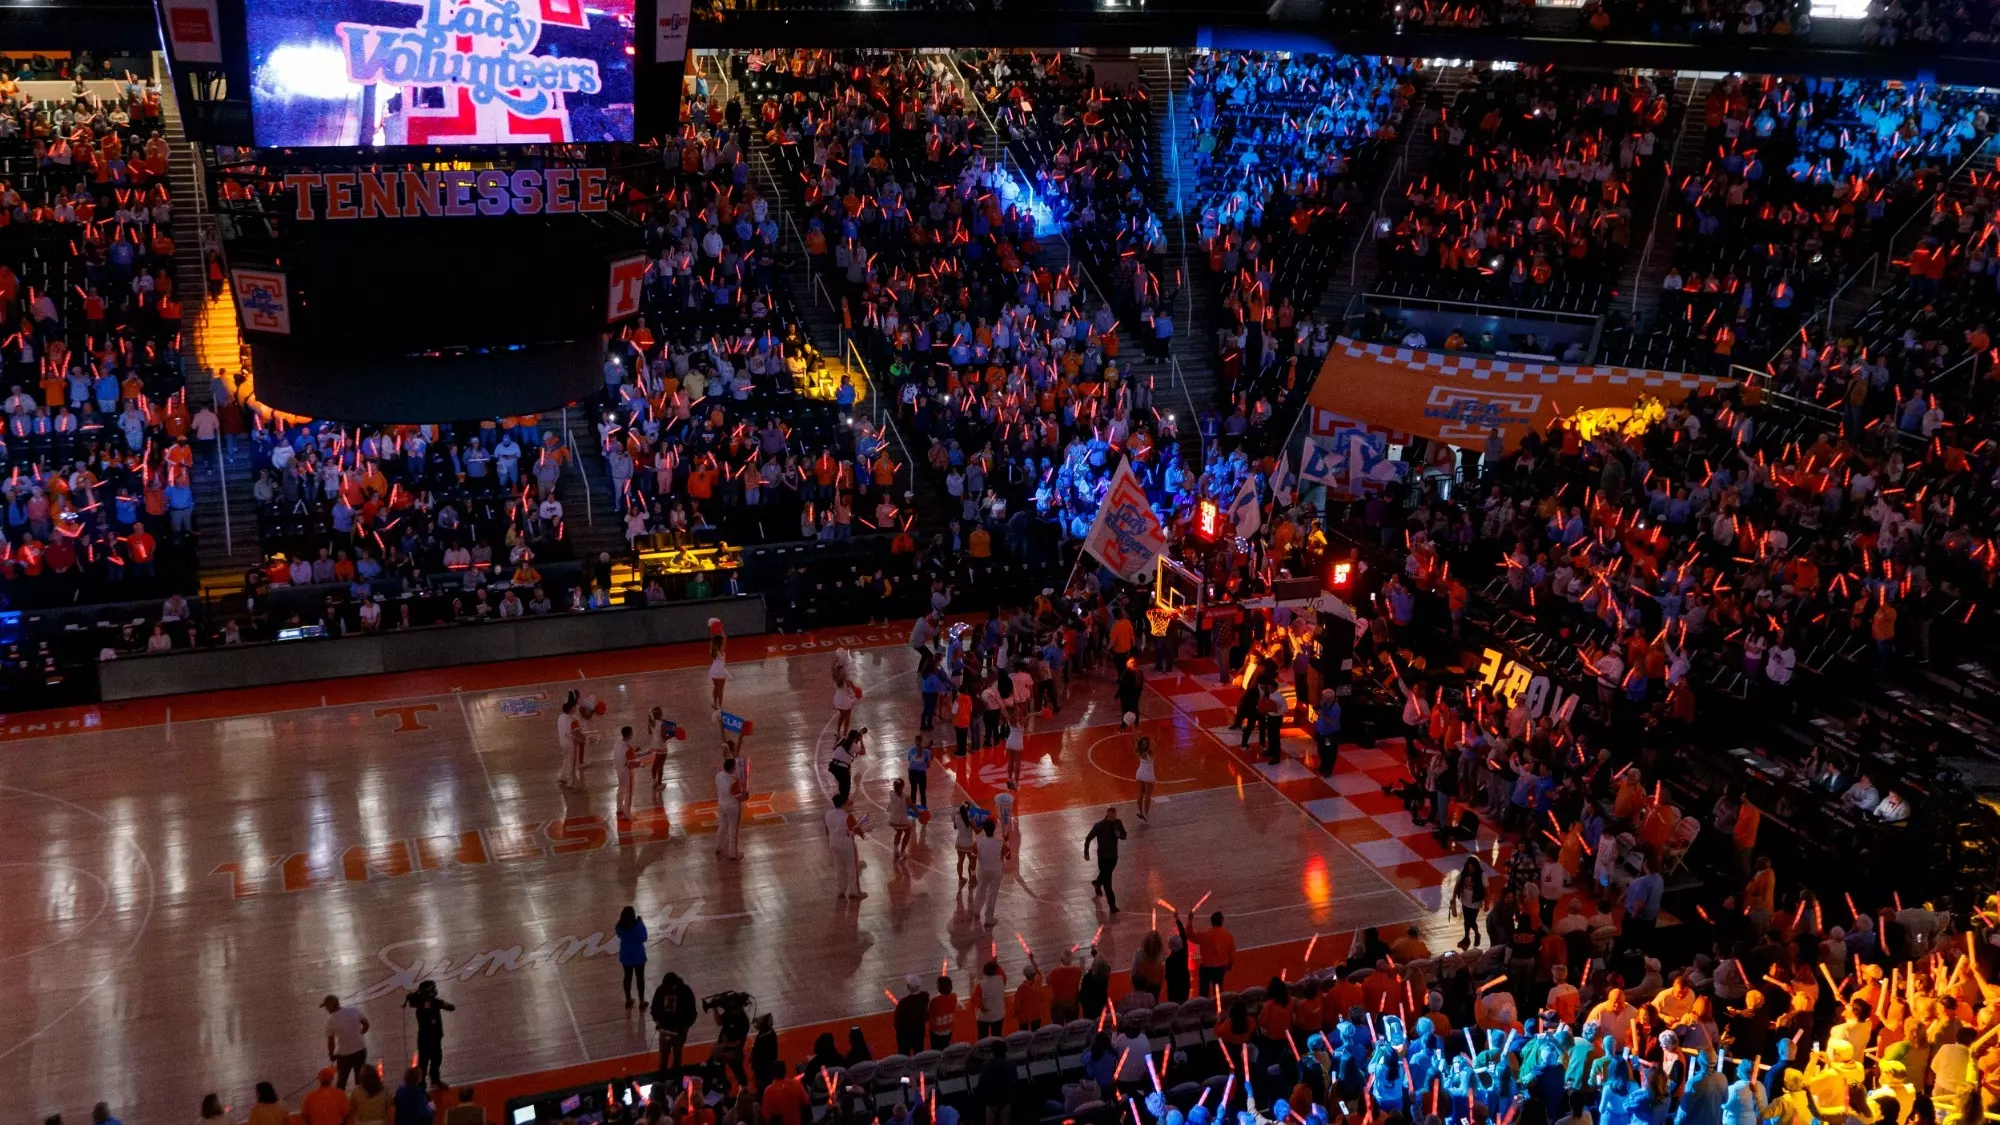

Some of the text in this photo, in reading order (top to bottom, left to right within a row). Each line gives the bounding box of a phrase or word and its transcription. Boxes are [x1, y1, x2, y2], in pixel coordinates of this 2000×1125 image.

[424, 0, 537, 52] Lady
[343, 27, 598, 116] Volunteers
[285, 168, 607, 220] TENNESSEE
[611, 256, 646, 312] T
[767, 639, 834, 654] FOOD
[866, 631, 914, 643] CIT
[372, 702, 439, 734] T
[338, 896, 762, 1007] Summtt
